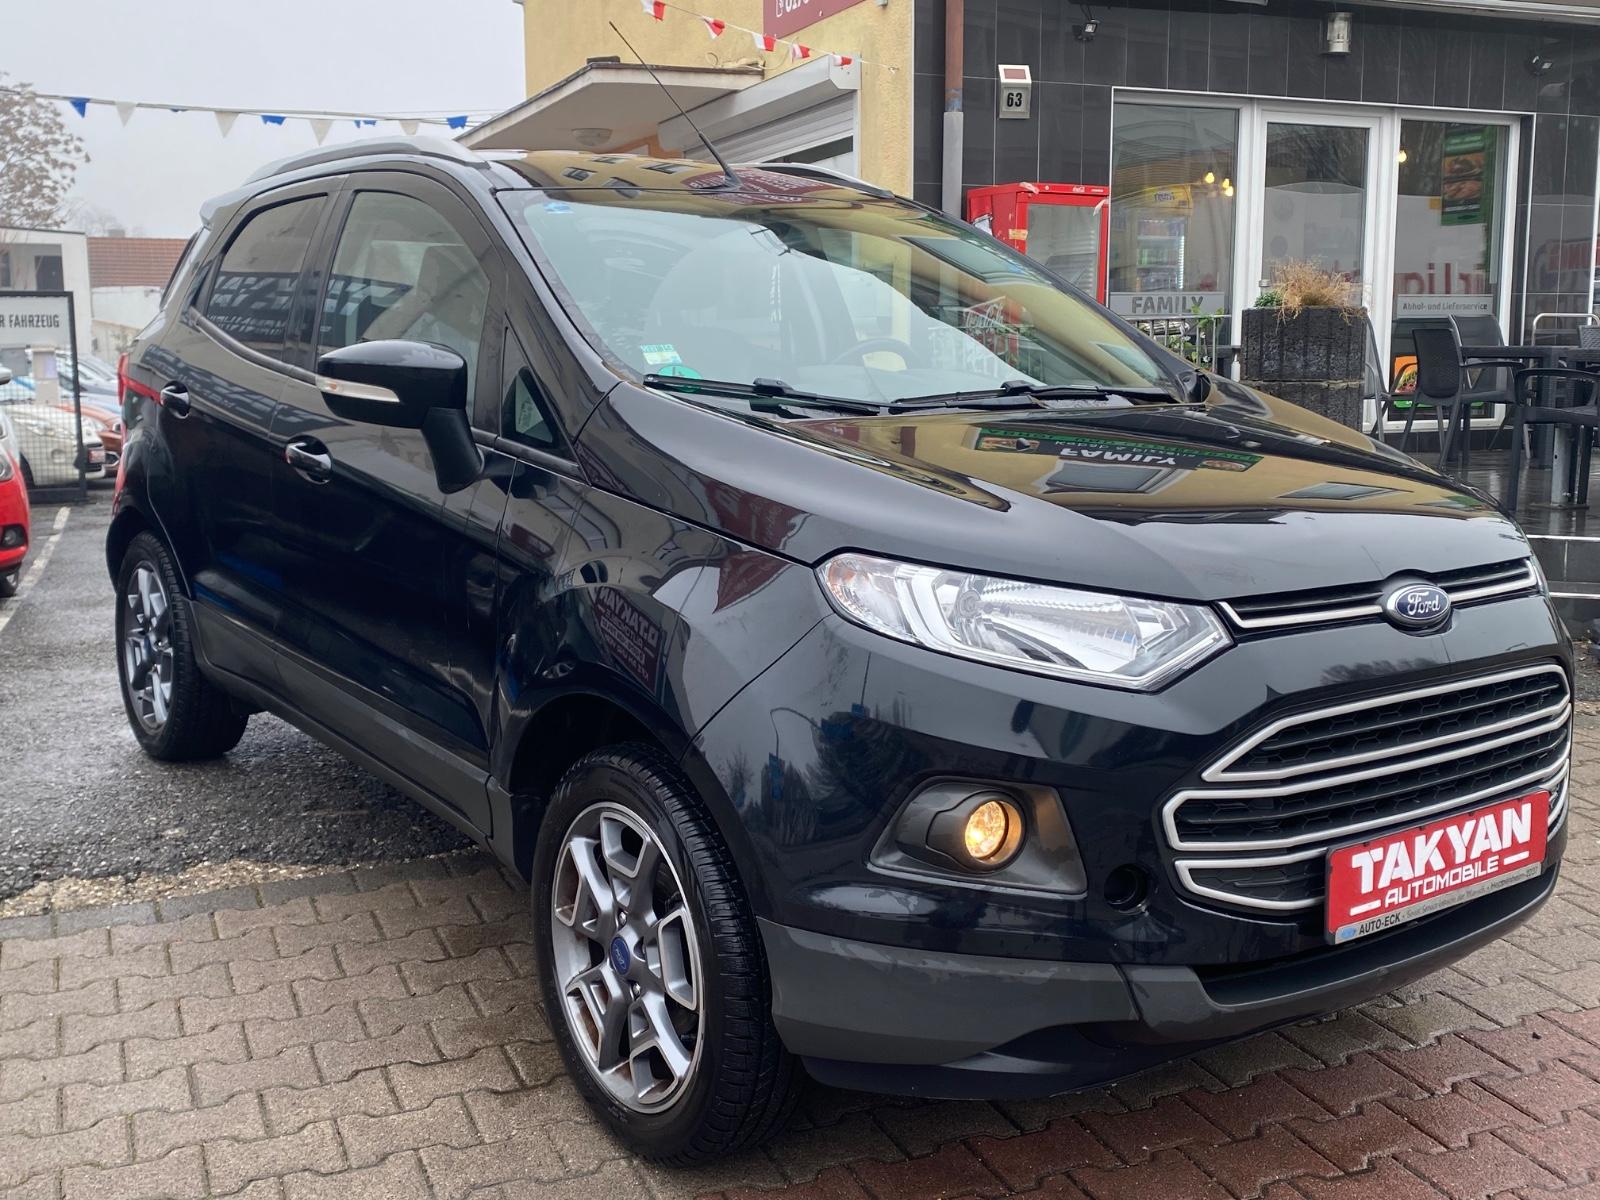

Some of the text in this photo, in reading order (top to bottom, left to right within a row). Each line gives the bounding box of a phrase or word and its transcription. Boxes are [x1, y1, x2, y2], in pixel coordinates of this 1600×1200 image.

[1007, 92, 1023, 107] 63
[1131, 295, 1204, 314] FAMILY
[1402, 301, 1488, 311] Abhol- und Lieferservice
[8, 314, 60, 328] FAHRZEUG
[1407, 591, 1440, 616] Ford
[1352, 802, 1532, 895] TAKYAN
[1384, 855, 1500, 908] AUTOMOBILE
[1358, 912, 1402, 935] AUTO-ECK
